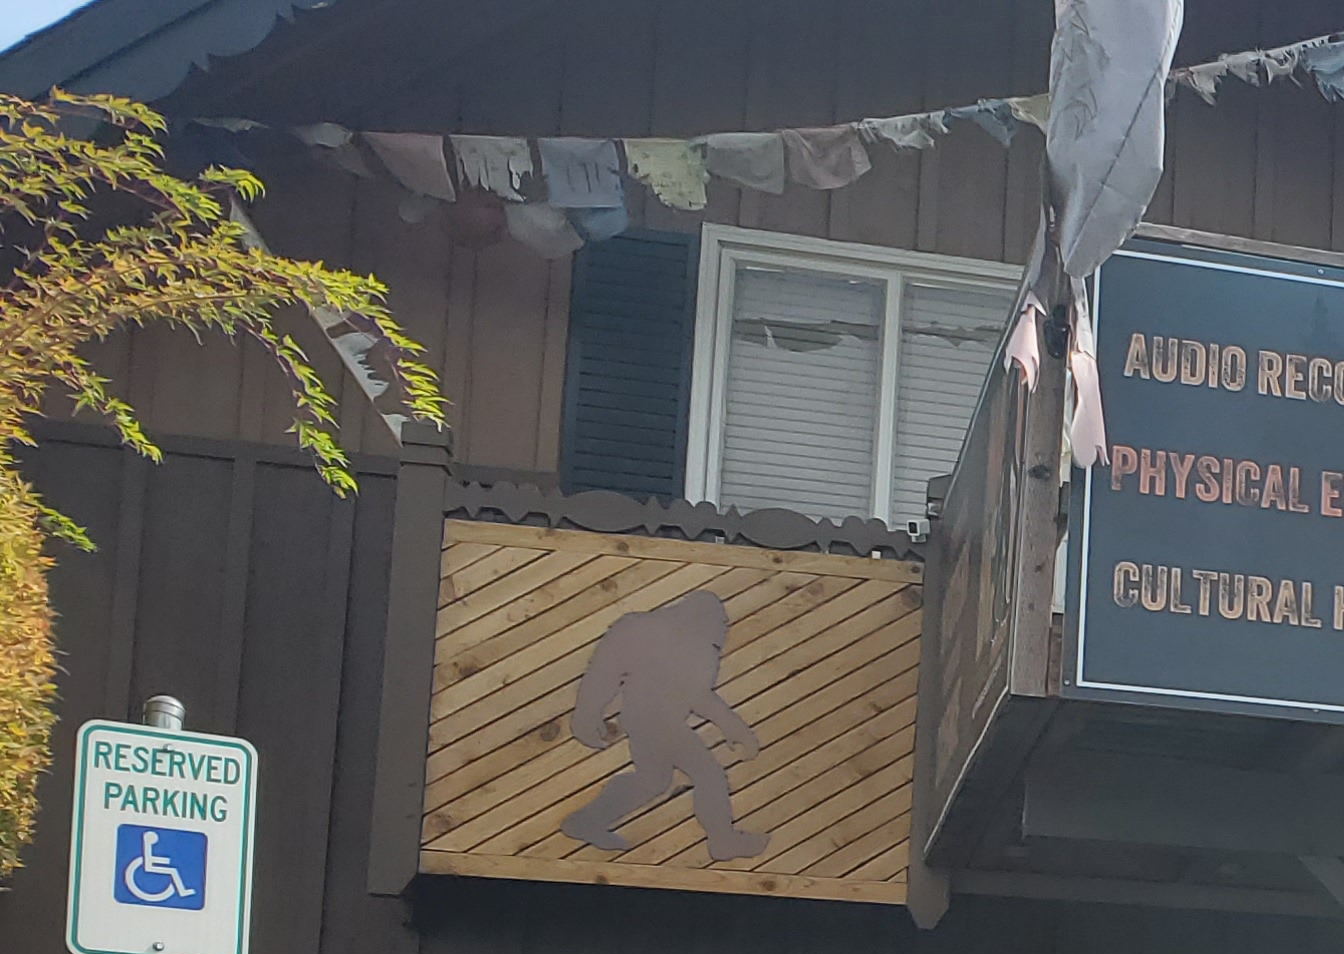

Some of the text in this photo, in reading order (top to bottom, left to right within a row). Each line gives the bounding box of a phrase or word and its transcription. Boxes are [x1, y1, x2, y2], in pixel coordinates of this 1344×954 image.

[1124, 333, 1247, 392] AUDIO
[1111, 445, 1309, 513] PHYSICAL
[1113, 561, 1322, 628] CULTURAL
[93, 741, 241, 786] RESERVED
[103, 783, 228, 822] PARKING
